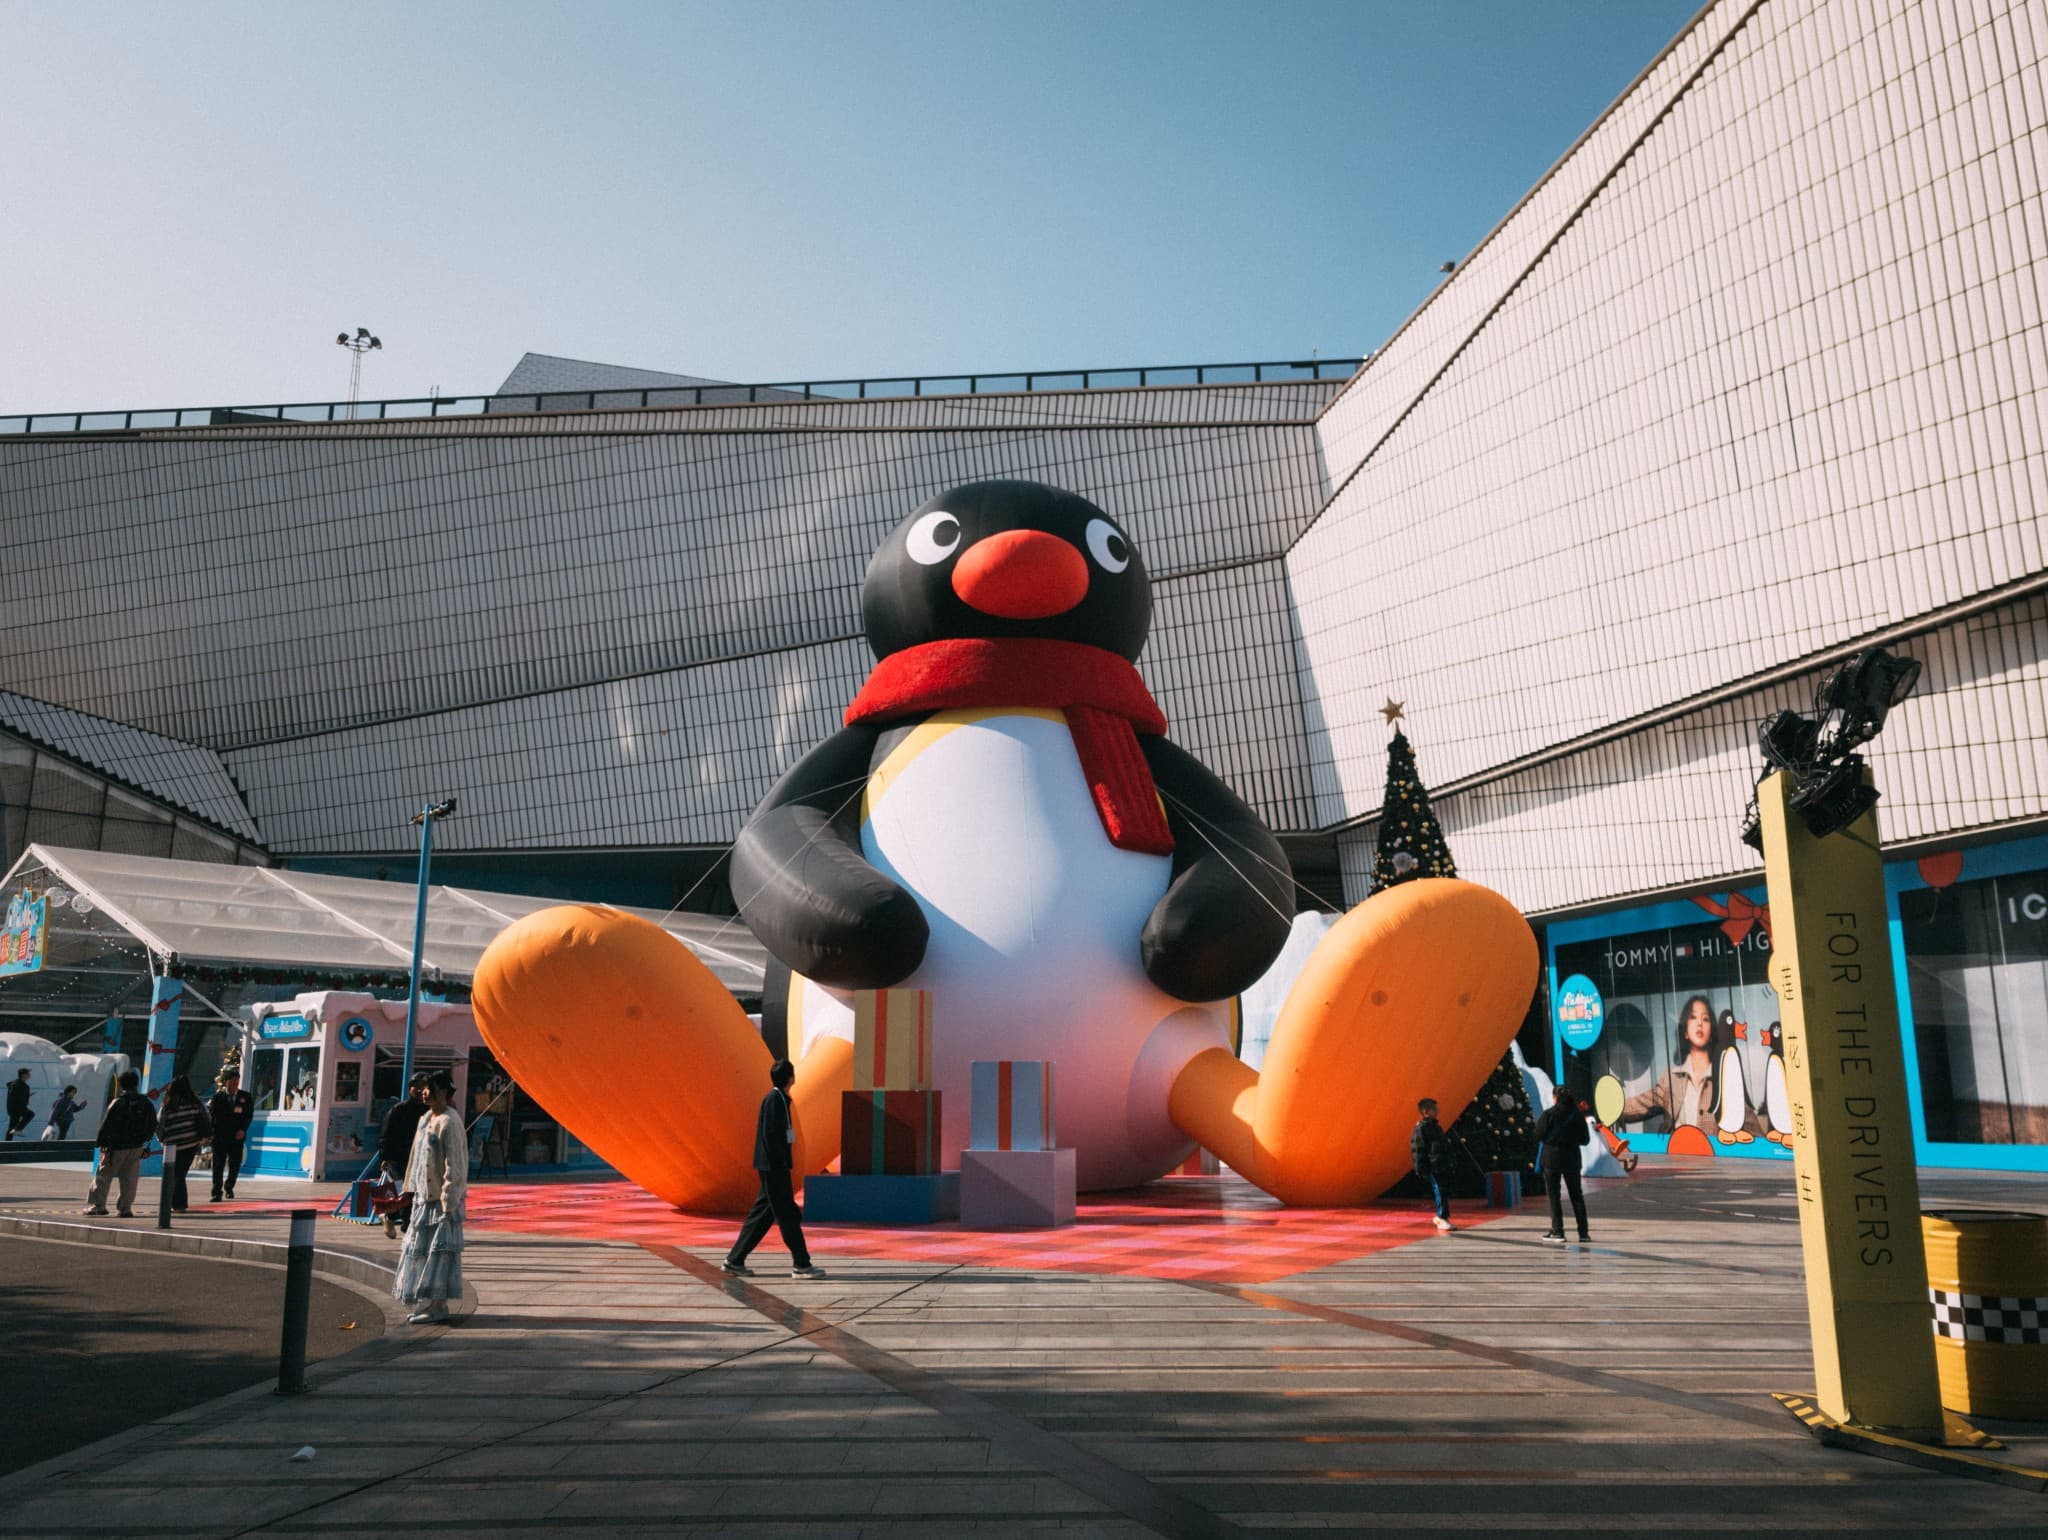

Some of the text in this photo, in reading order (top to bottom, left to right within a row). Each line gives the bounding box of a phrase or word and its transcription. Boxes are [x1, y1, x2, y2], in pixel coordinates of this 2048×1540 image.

[1604, 944, 1669, 968] TOMMY
[1825, 912, 1893, 1266] FOR THE DRIVERS
